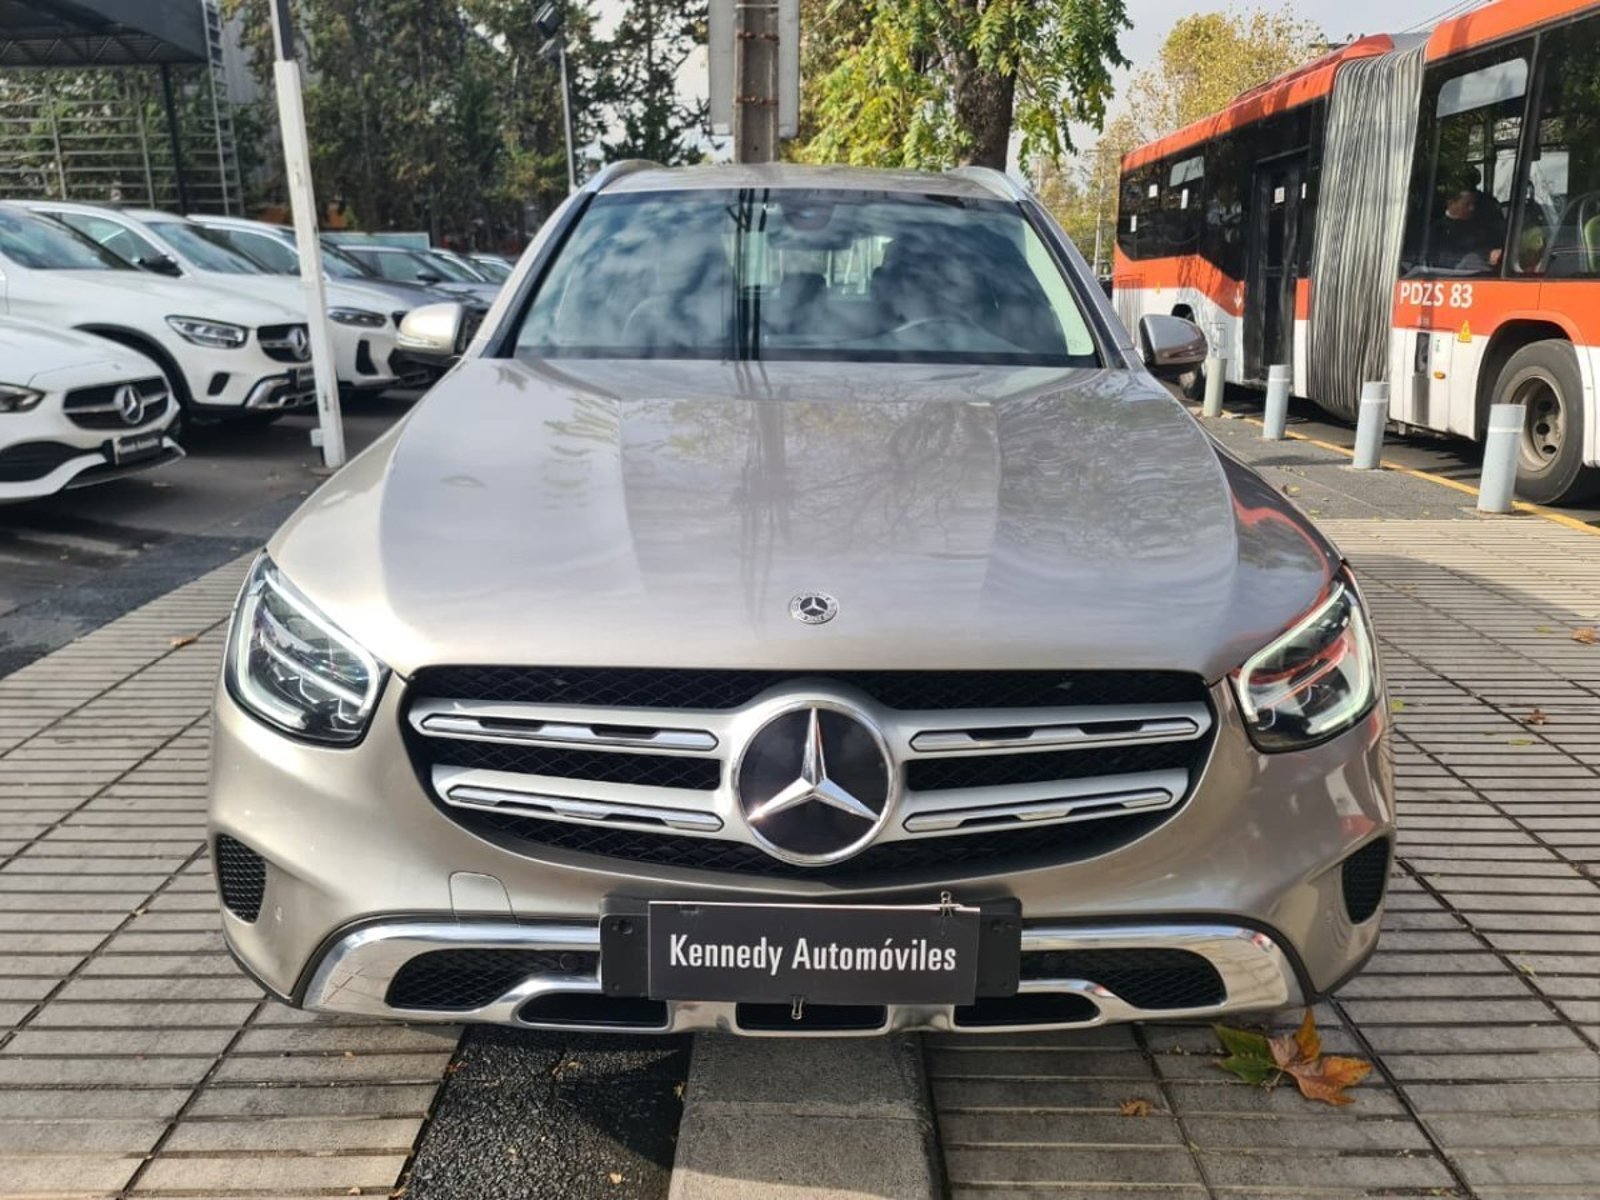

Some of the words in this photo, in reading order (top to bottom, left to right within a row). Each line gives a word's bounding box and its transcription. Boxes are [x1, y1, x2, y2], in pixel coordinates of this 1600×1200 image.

[1400, 282, 1444, 307] PDZS
[1450, 283, 1473, 308] 83
[670, 934, 783, 976] Kennedy
[791, 937, 957, 971] Automóviles
